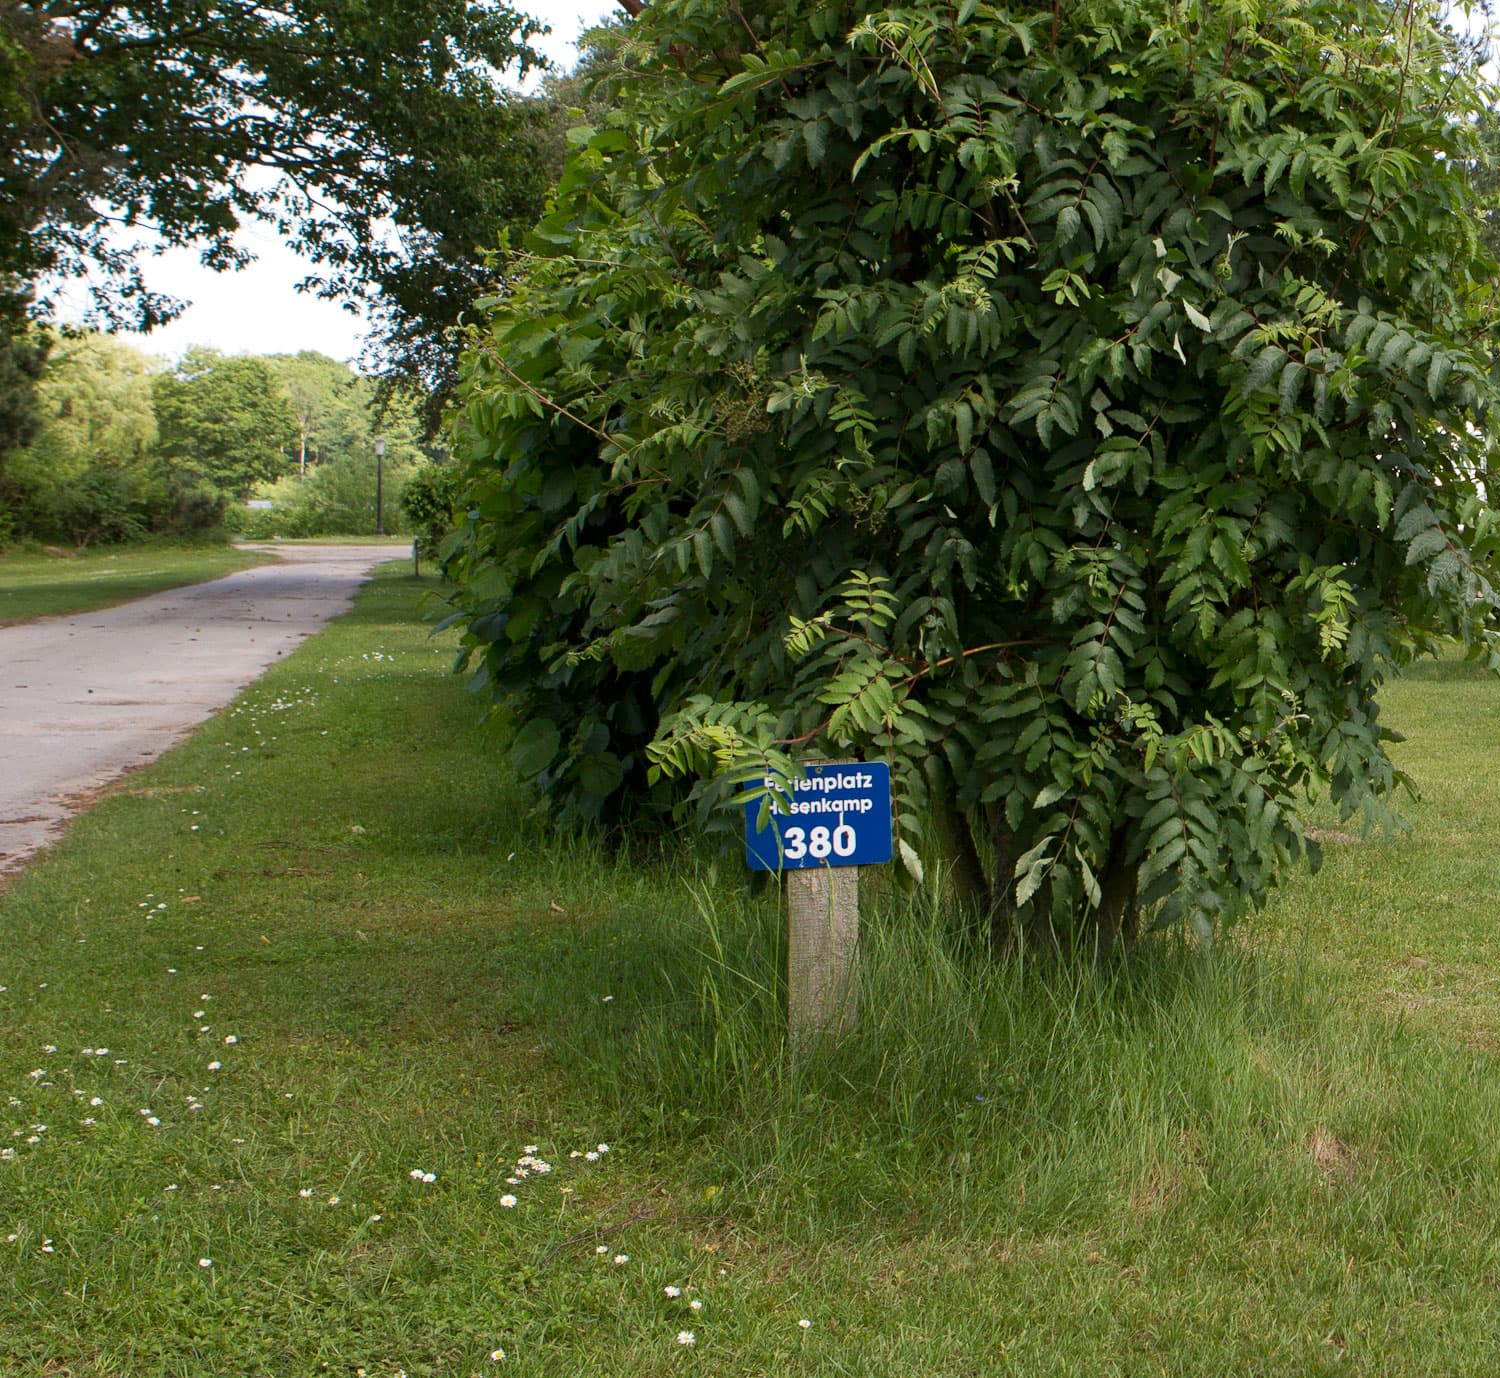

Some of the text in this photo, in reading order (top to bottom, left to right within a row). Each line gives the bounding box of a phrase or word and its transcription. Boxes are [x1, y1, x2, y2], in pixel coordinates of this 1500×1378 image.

[764, 772, 873, 794] Fienplatz
[768, 798, 873, 816] Hsenkamp
[784, 825, 857, 860] 380
